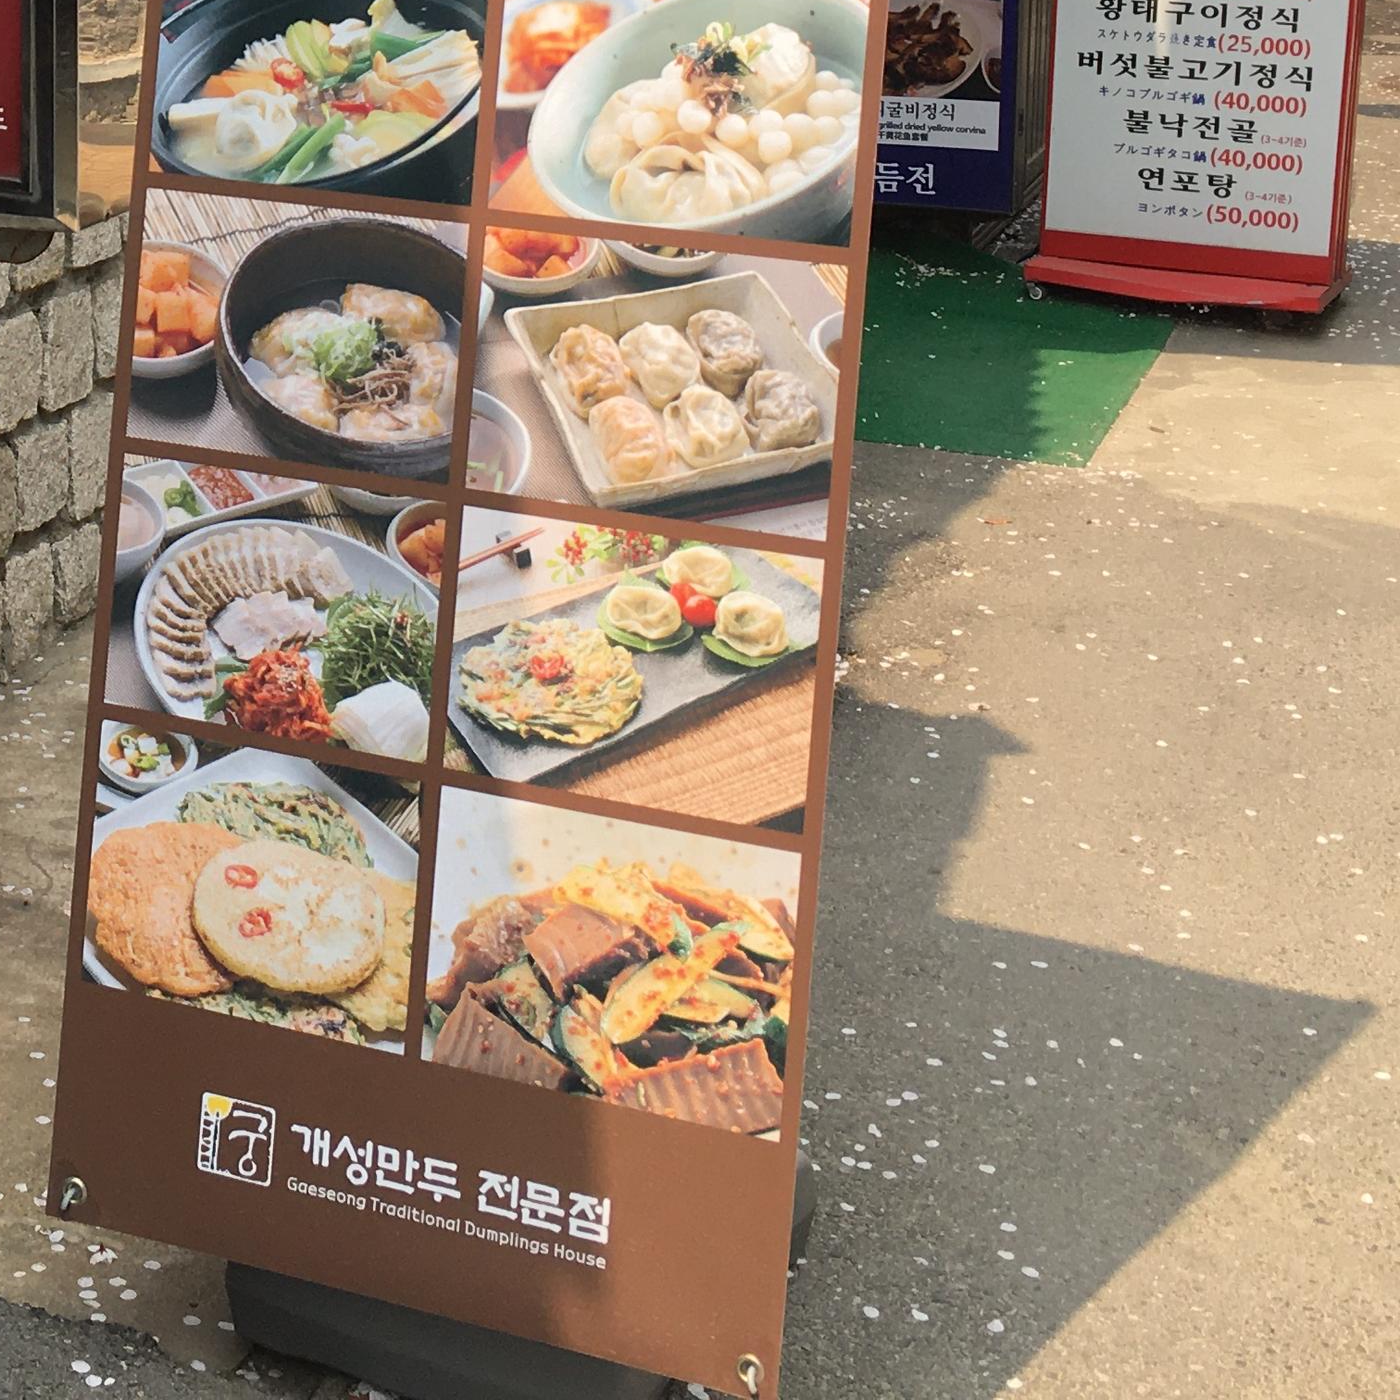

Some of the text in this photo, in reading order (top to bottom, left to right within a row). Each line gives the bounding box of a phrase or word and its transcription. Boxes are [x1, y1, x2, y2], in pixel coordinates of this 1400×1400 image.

[1217, 33, 1312, 60] (25,000)
[1076, 50, 1314, 92] 버섯불고기정식
[1214, 90, 1307, 118] (40,000)
[904, 122, 926, 131] dried
[927, 122, 954, 133] yellow
[955, 125, 987, 135] corvina
[1122, 109, 1258, 144] 불낙전골
[1210, 147, 1303, 175] (40,000)
[1137, 166, 1238, 199] 연포탕
[1206, 203, 1300, 233] (50,000)
[290, 1123, 612, 1246] 개성만두 전문점
[286, 1176, 607, 1271] Gaeseong Traditional Dumplings House
